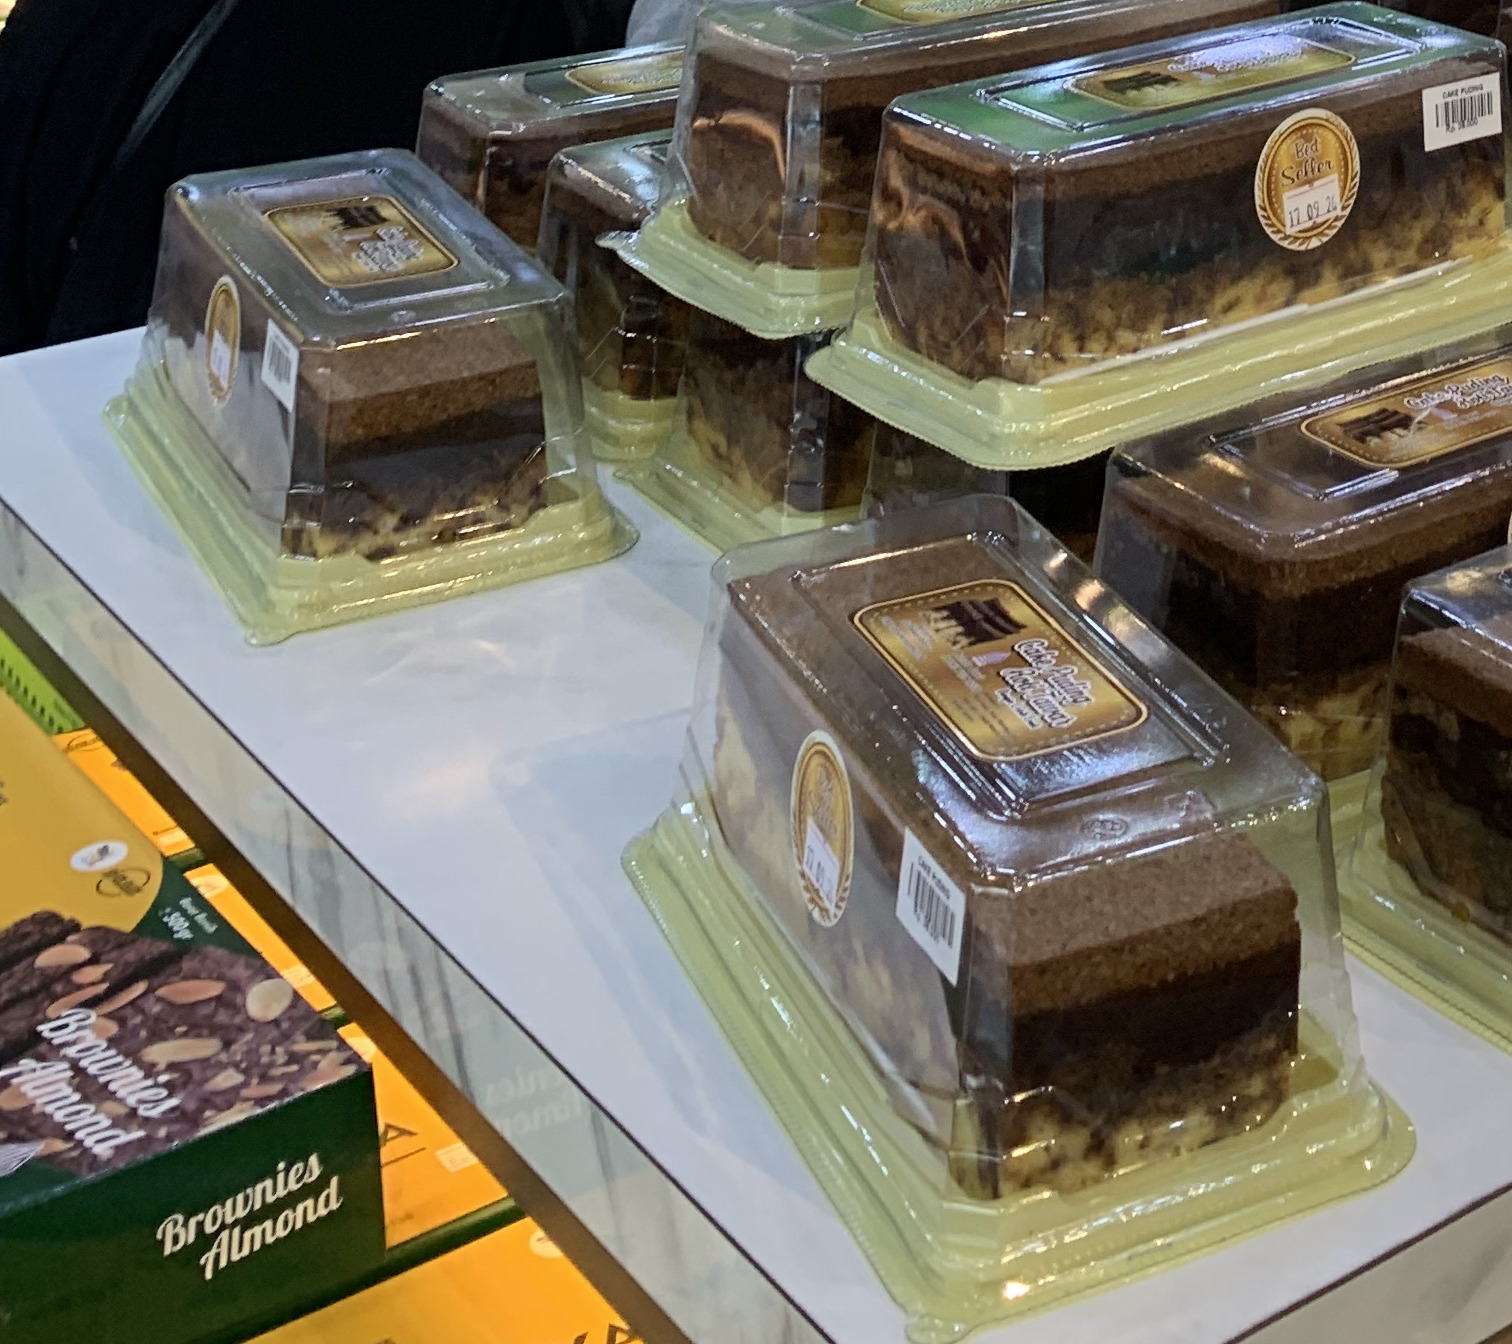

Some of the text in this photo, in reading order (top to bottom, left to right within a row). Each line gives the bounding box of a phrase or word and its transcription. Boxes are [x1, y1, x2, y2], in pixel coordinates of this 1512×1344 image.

[1442, 82, 1484, 100] CAKE PUDING
[1294, 135, 1321, 162] Best
[1280, 157, 1335, 188] Seller
[1305, 199, 1322, 222] 09
[1012, 636, 1059, 672] Cake
[34, 1006, 184, 1120] Brownies
[15, 1057, 147, 1159] Almond
[155, 1152, 324, 1258] Brownies
[199, 1175, 345, 1281] Almond
